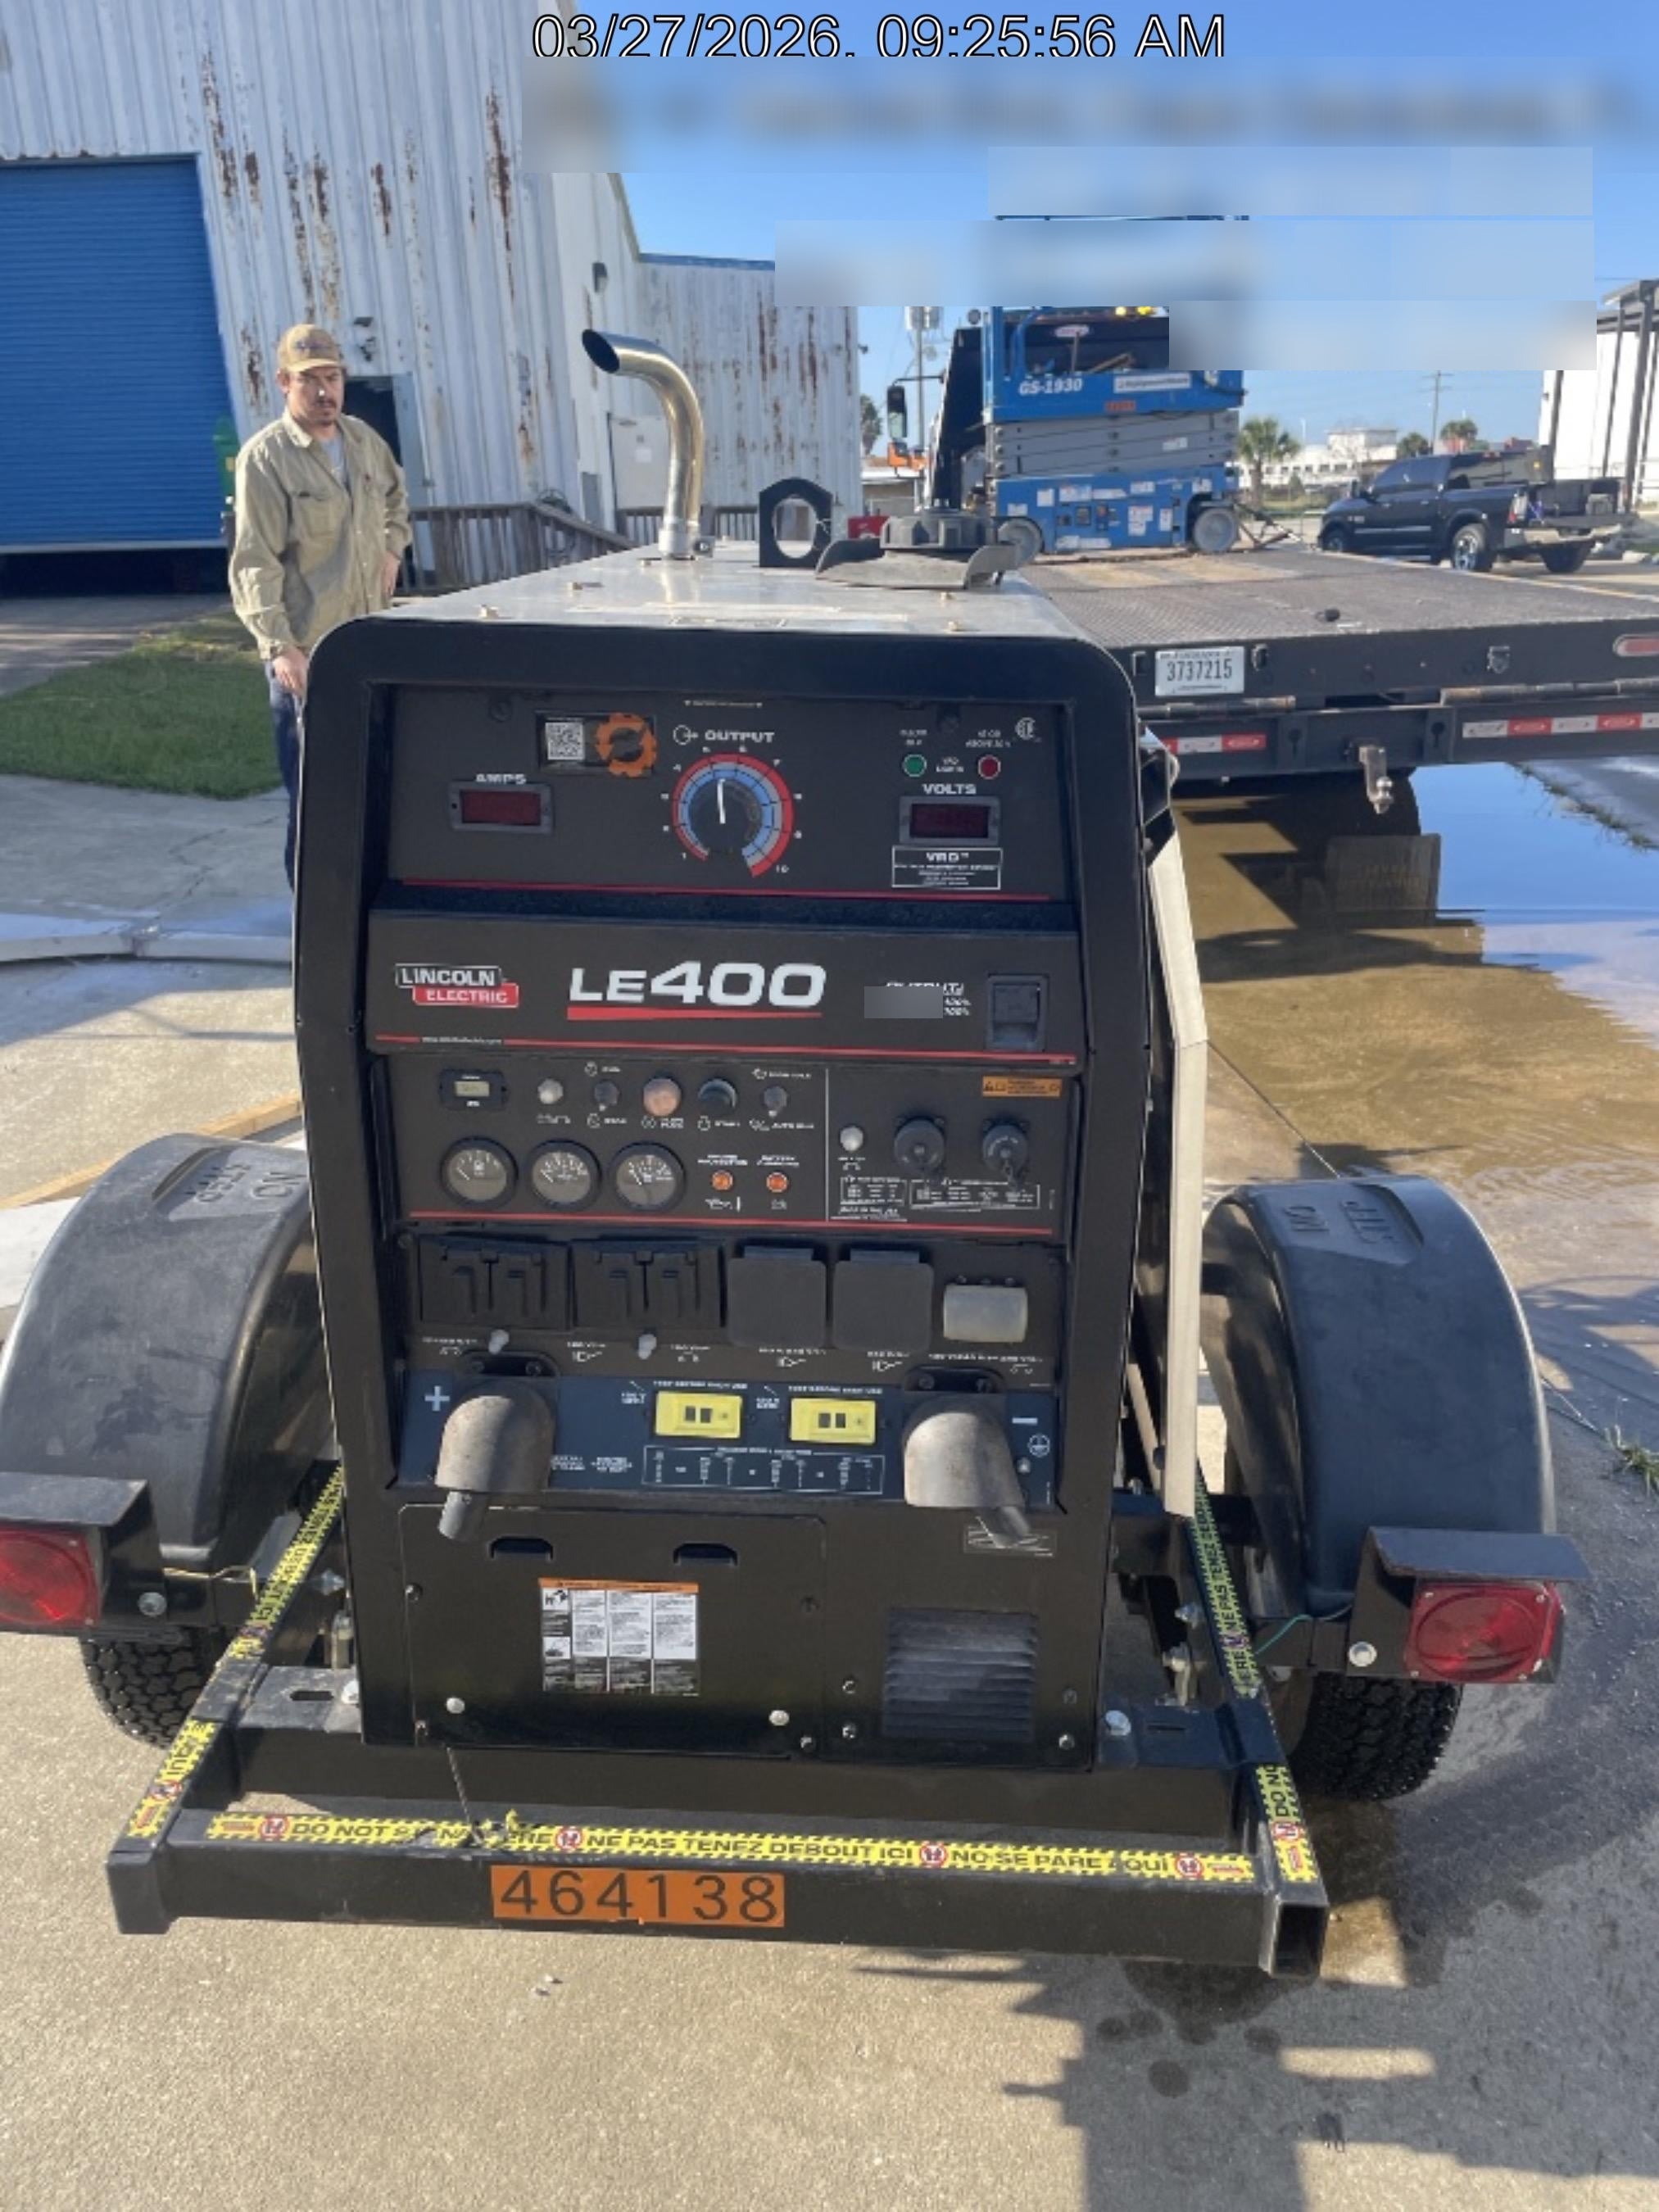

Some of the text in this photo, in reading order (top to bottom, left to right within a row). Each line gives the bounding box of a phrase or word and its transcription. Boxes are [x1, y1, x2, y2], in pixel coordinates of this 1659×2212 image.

[1019, 378, 1082, 397] GS-1930
[1167, 658, 1233, 682] 3737215
[705, 730, 775, 743] OUTPUT
[476, 774, 527, 785] AMPS
[922, 783, 977, 795] VOLTS
[401, 968, 496, 986] LINCOLN
[569, 960, 827, 1007] LE400
[425, 989, 509, 1004] ELECTRIC
[292, 1823, 329, 1834] DO
[334, 1826, 390, 1837] NOT
[587, 1835, 623, 1847] NE
[628, 1837, 676, 1849] PAS
[682, 1838, 764, 1852] TENEZ
[769, 1843, 875, 1857] DEBOUT
[879, 1847, 913, 1860] ICI
[952, 1850, 988, 1863] NO
[995, 1852, 1029, 1865] SE
[1035, 1855, 1103, 1869] PARE
[501, 1869, 777, 1922] 464138
